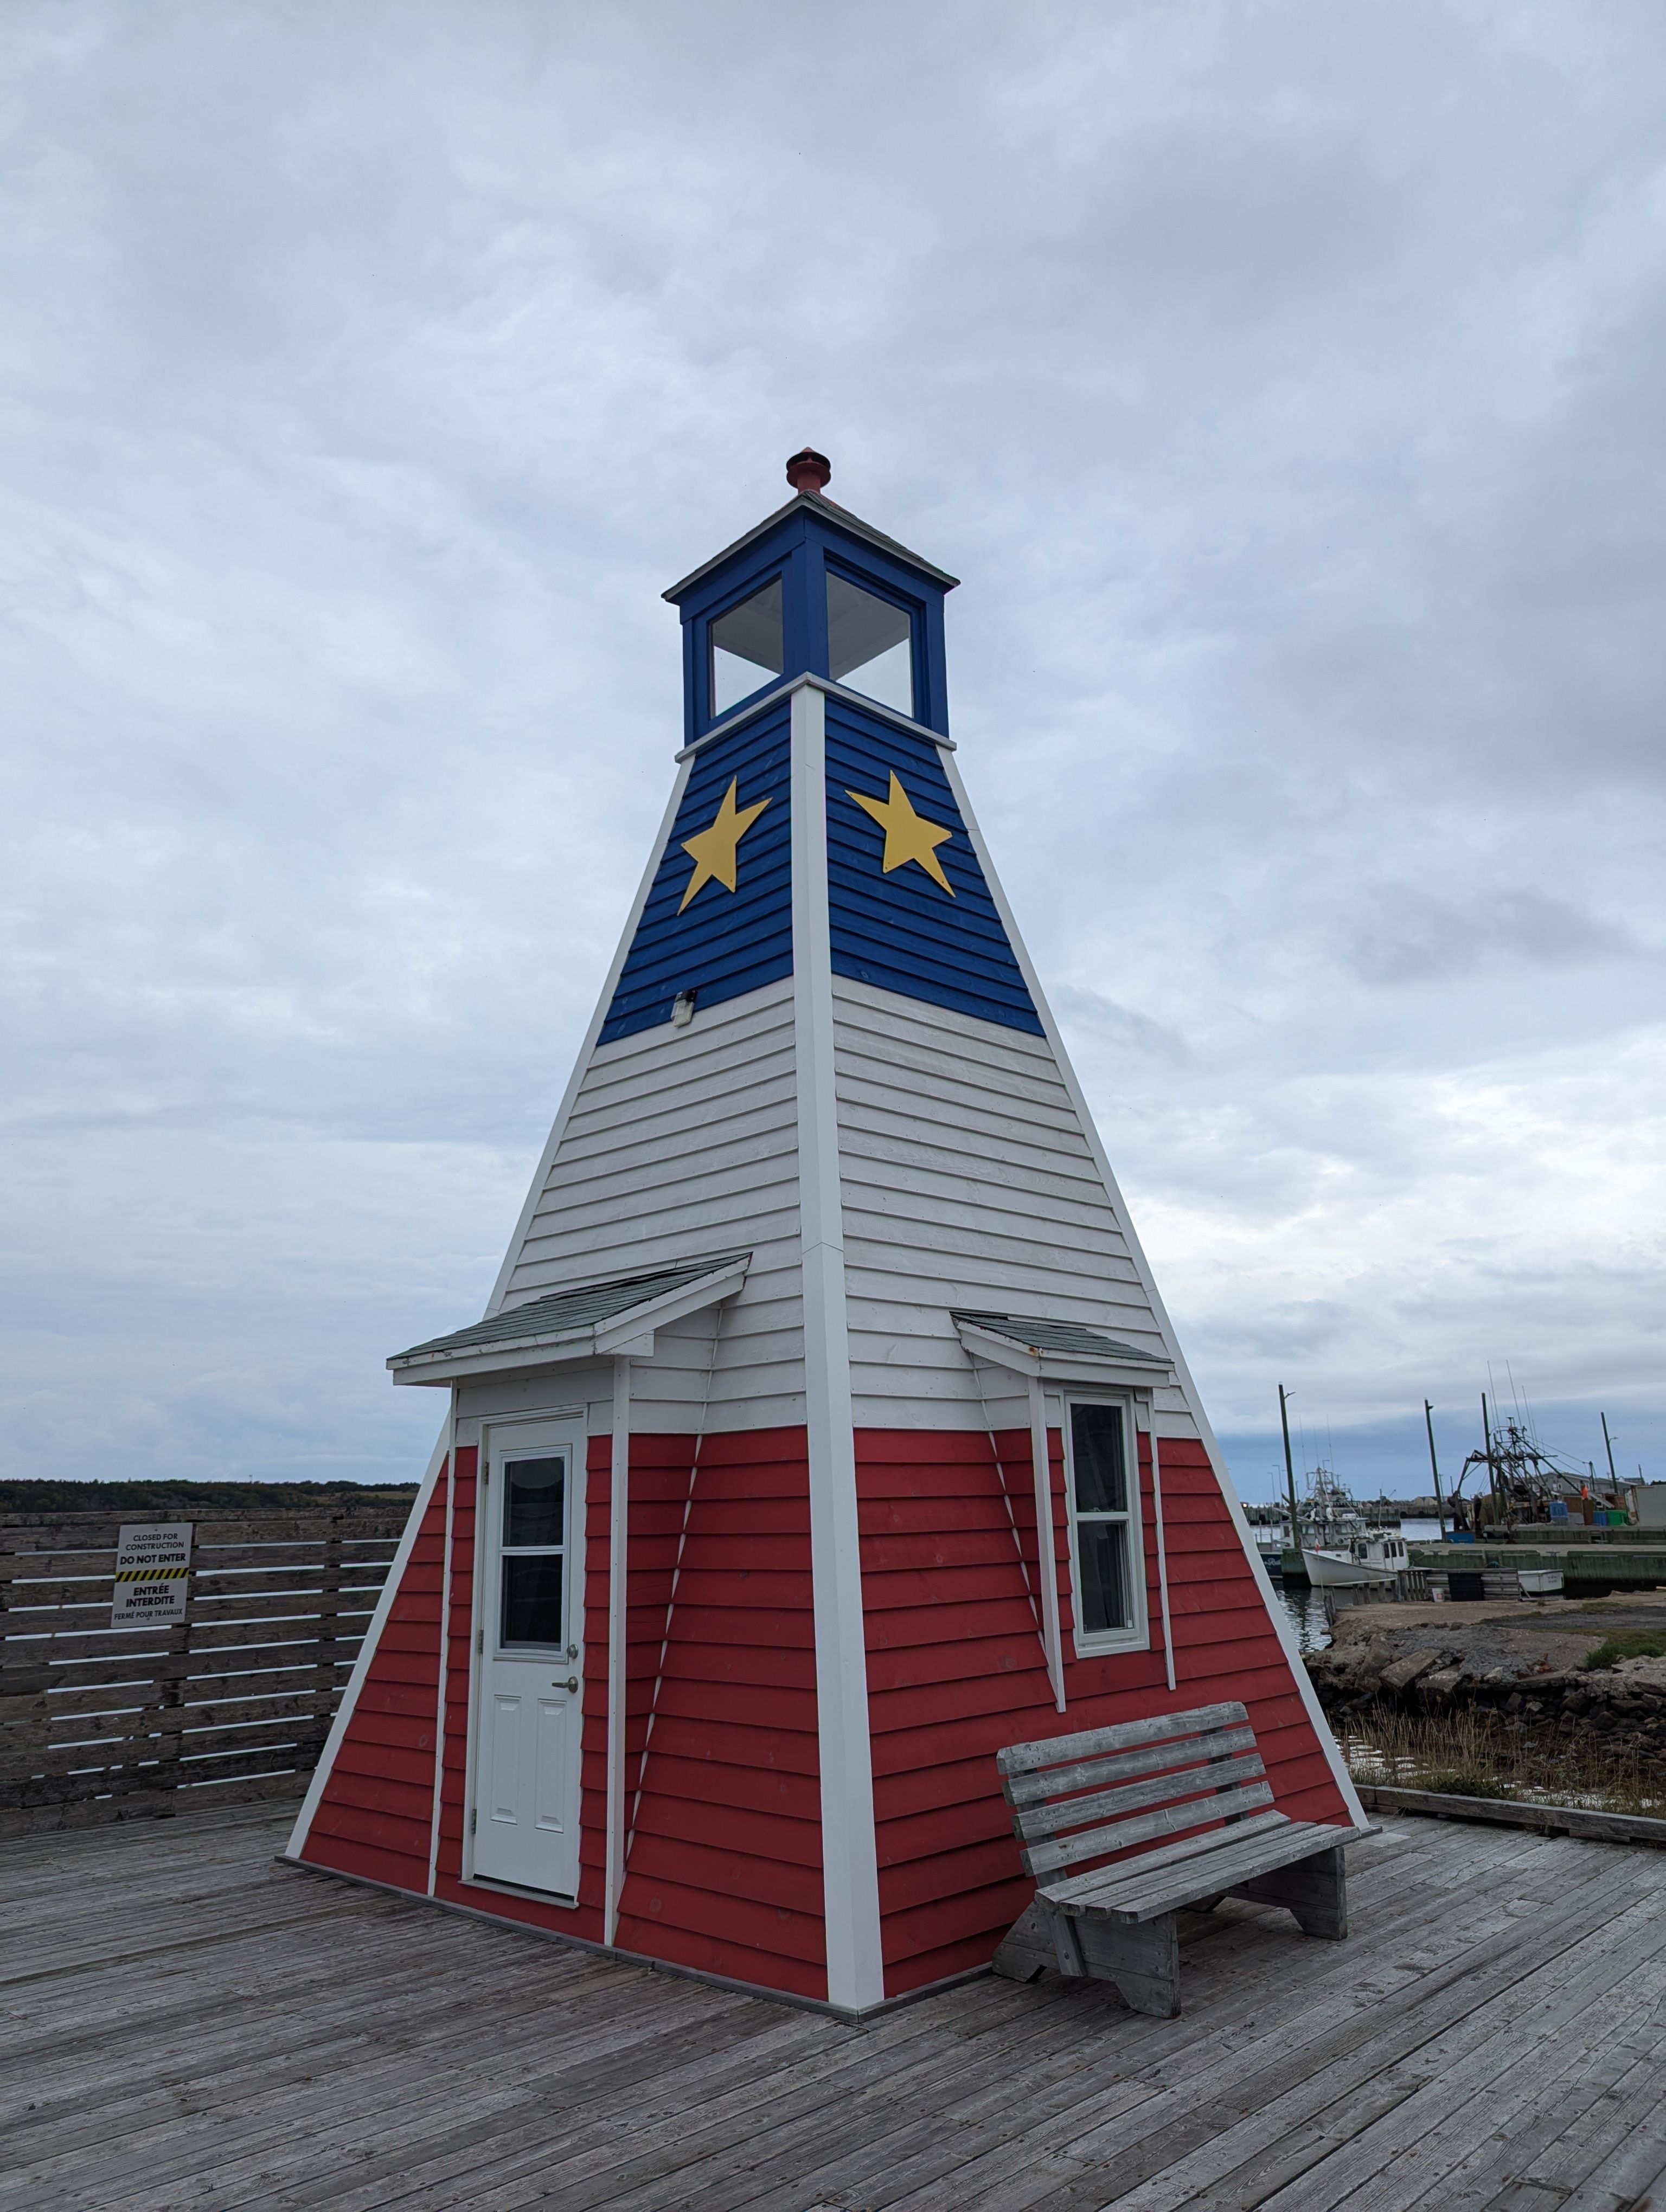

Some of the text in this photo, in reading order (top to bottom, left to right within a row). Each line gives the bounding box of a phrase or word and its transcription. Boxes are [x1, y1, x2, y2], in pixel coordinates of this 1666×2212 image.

[126, 1541, 184, 1551] CONSTRUCTION
[120, 1553, 186, 1565] DO NOT ENTER
[133, 1583, 170, 1596] ENTRÉE
[126, 1596, 175, 1607] INTERDITE
[114, 1609, 183, 1620] FERMÉ POUR TRAVAUX
